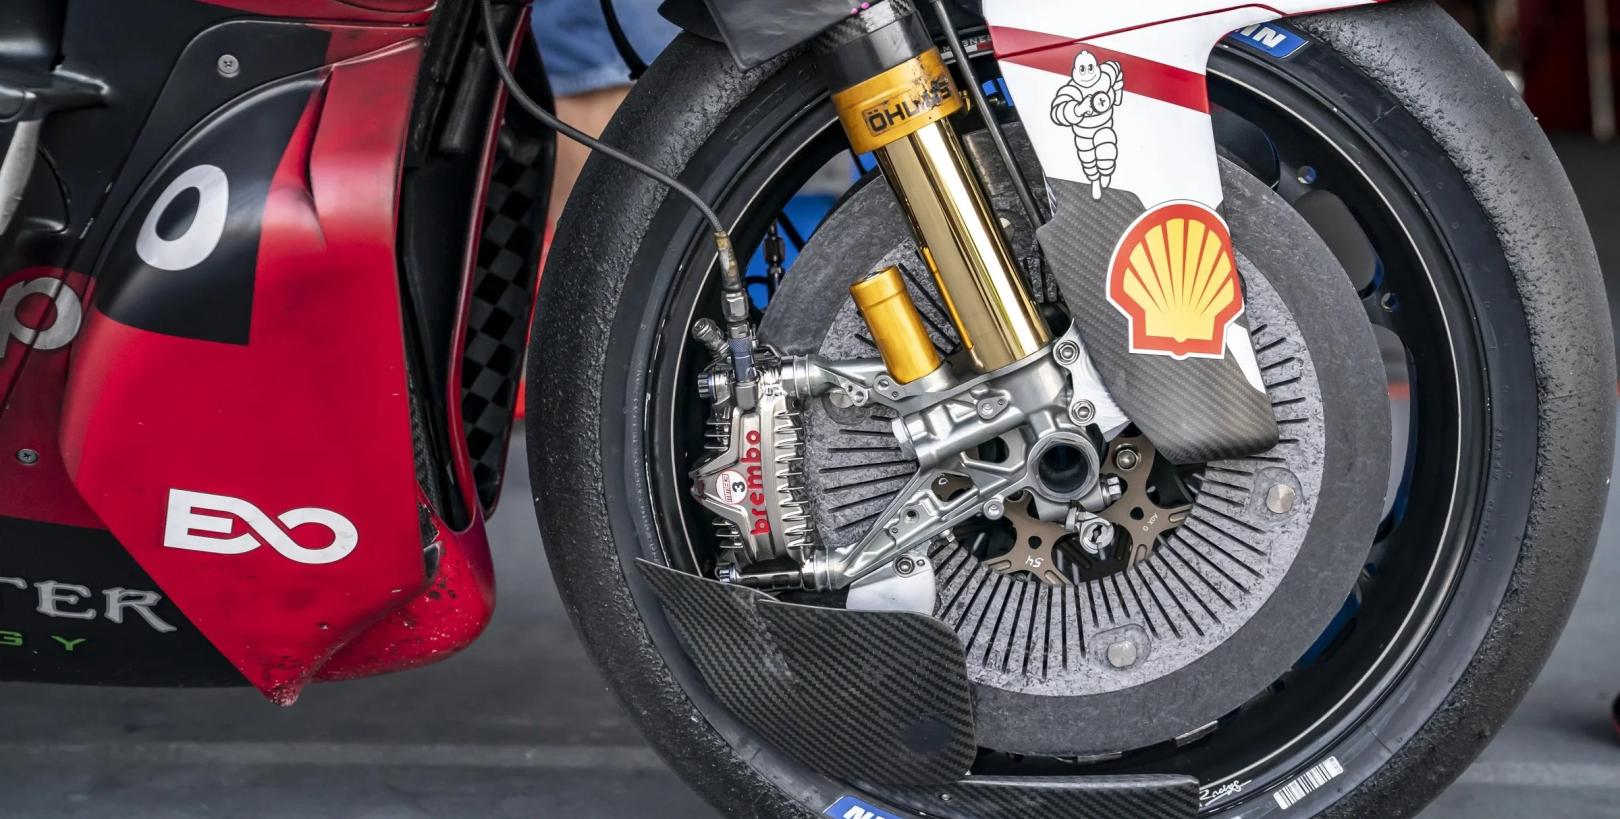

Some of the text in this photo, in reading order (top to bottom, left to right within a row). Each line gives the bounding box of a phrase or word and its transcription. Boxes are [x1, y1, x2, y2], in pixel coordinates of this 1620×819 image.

[732, 481, 746, 493] 3
[740, 430, 770, 536] brembo
[1025, 555, 1045, 568] 54
